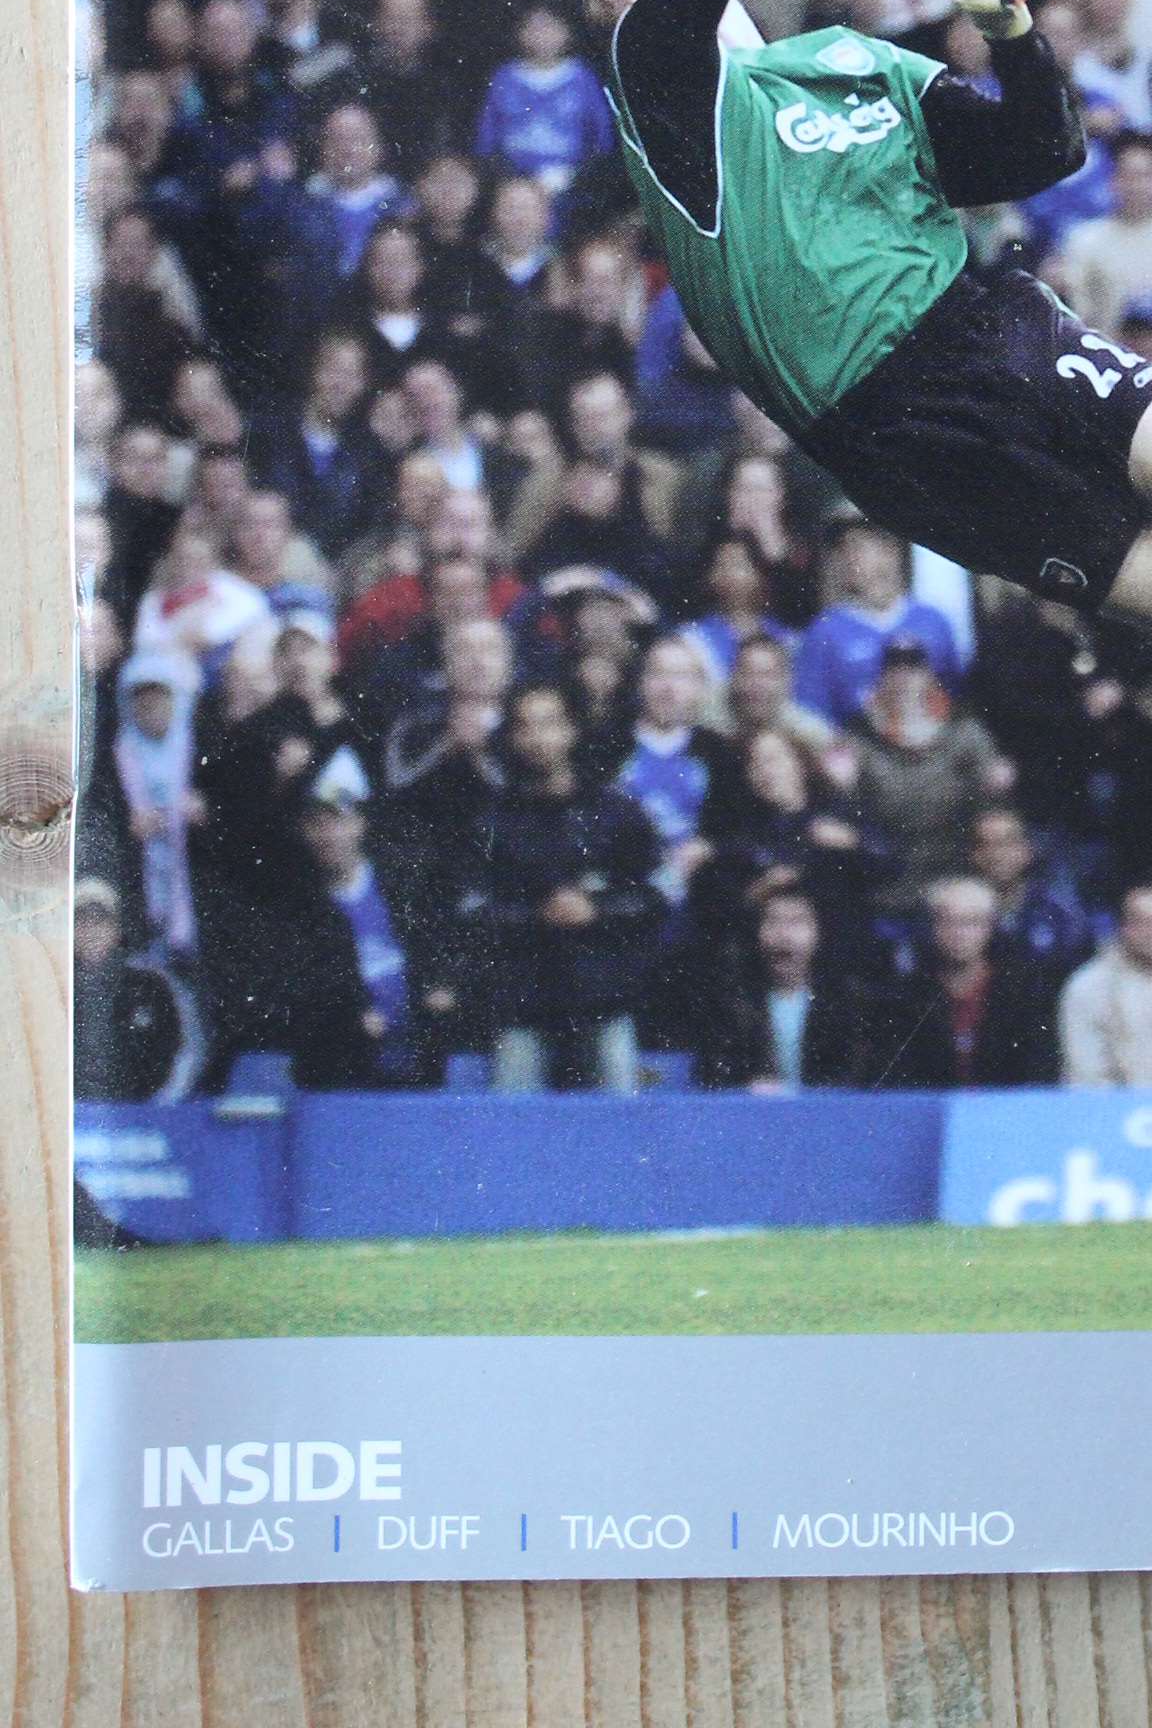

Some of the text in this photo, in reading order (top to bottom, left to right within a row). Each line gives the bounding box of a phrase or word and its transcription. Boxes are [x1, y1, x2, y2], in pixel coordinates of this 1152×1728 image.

[143, 1439, 402, 1508] INSIDE
[142, 1510, 1015, 1558] GALLAS DUFF TIAGO MOURINHO
